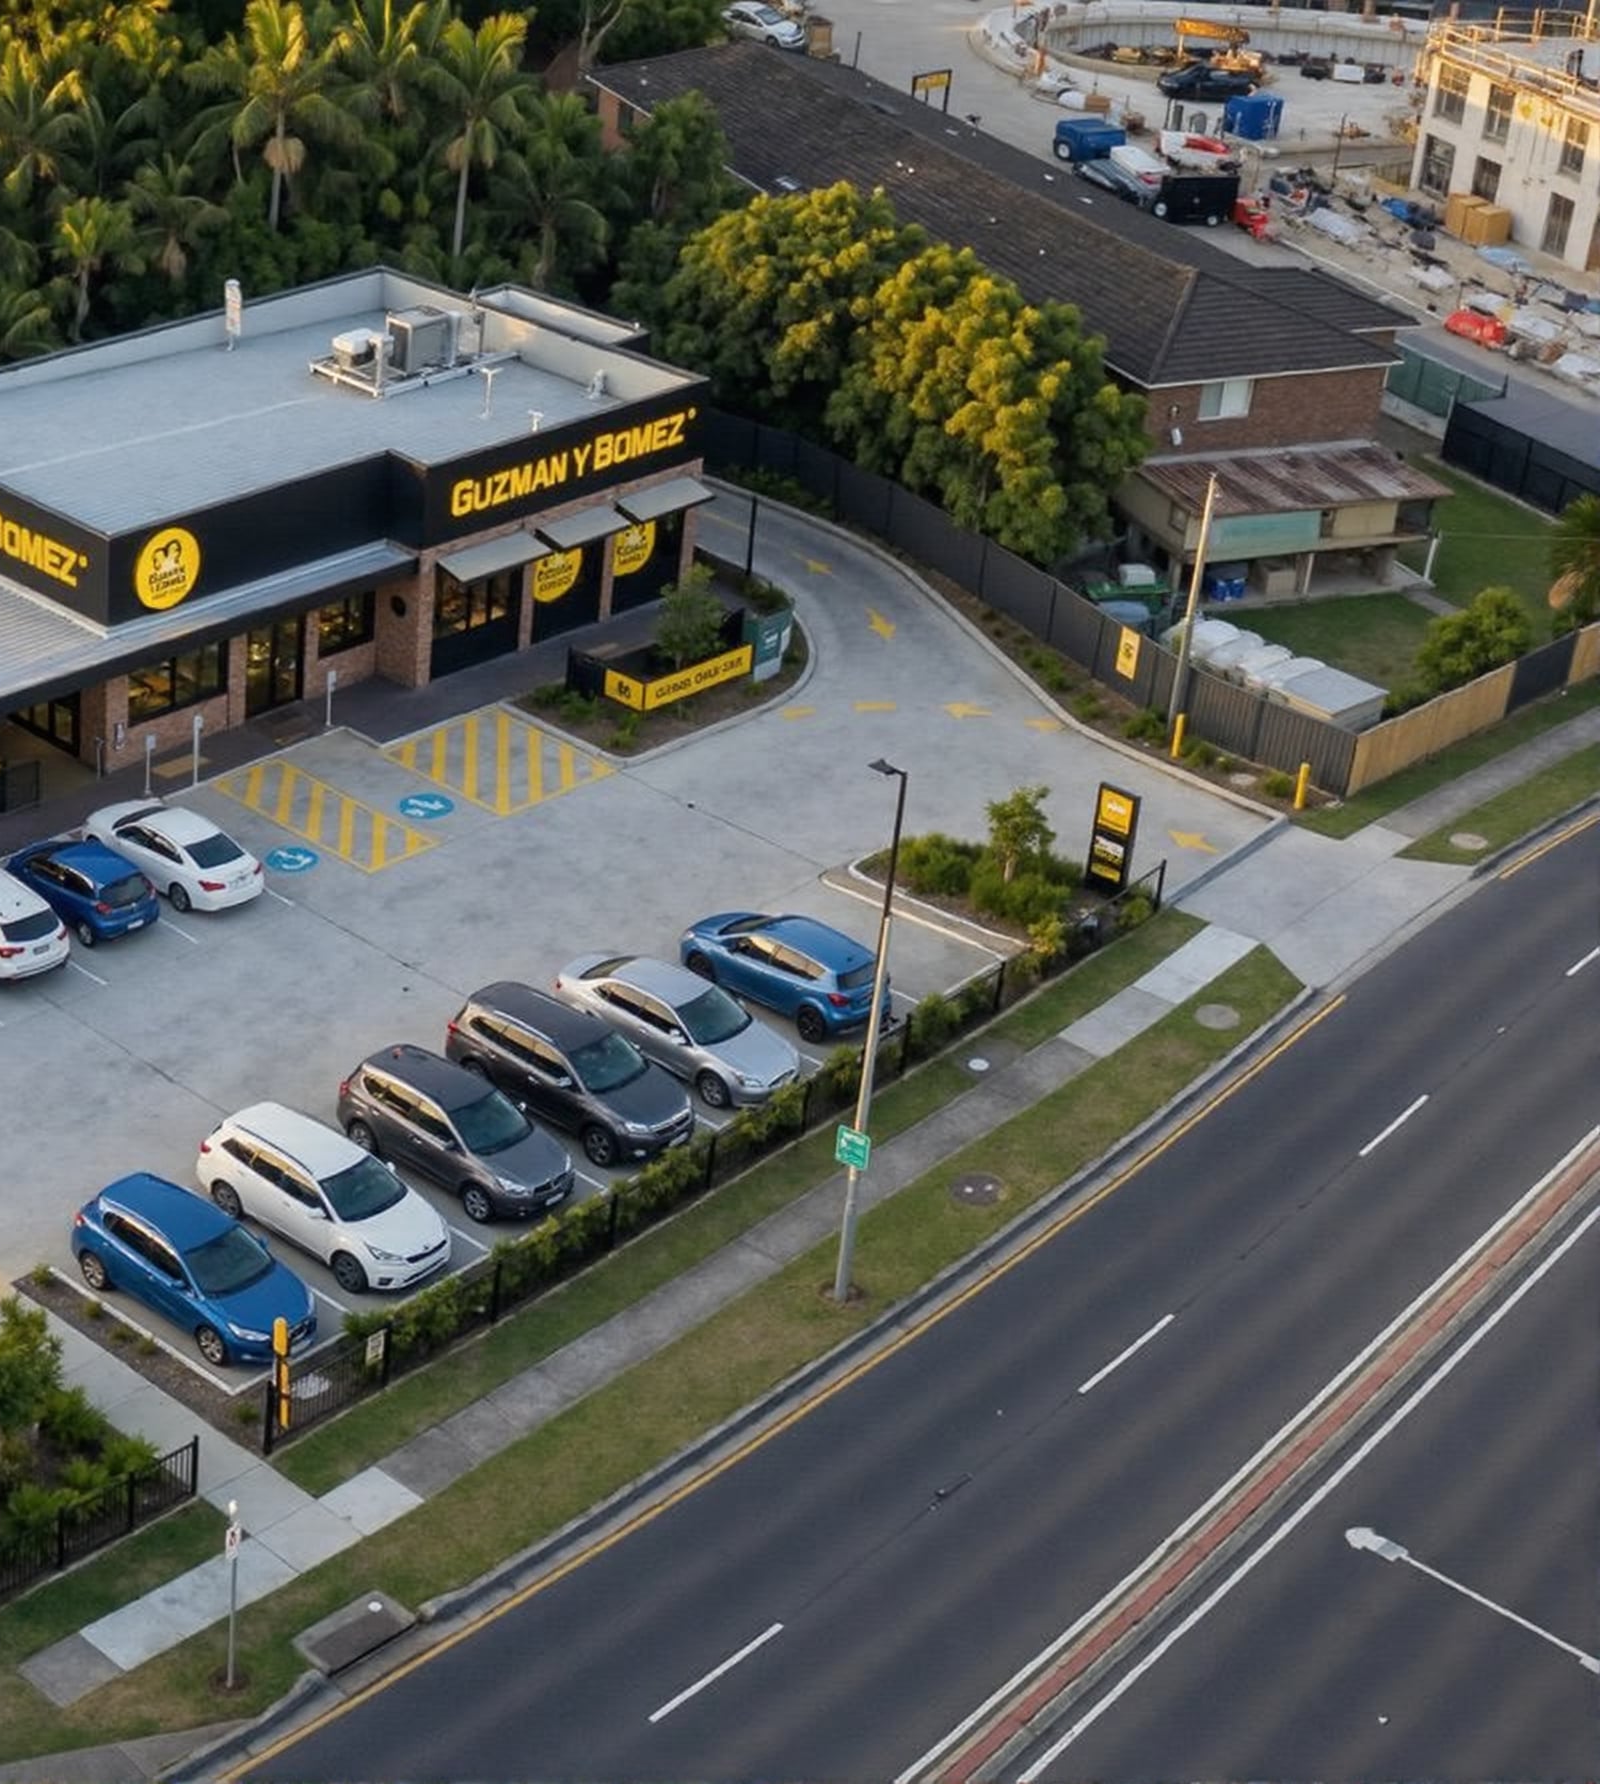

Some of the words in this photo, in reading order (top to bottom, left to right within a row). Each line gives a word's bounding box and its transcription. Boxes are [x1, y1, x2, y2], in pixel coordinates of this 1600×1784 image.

[451, 453, 568, 517] GUZMAN
[574, 443, 592, 477] Y
[594, 412, 684, 471] BOMEZ
